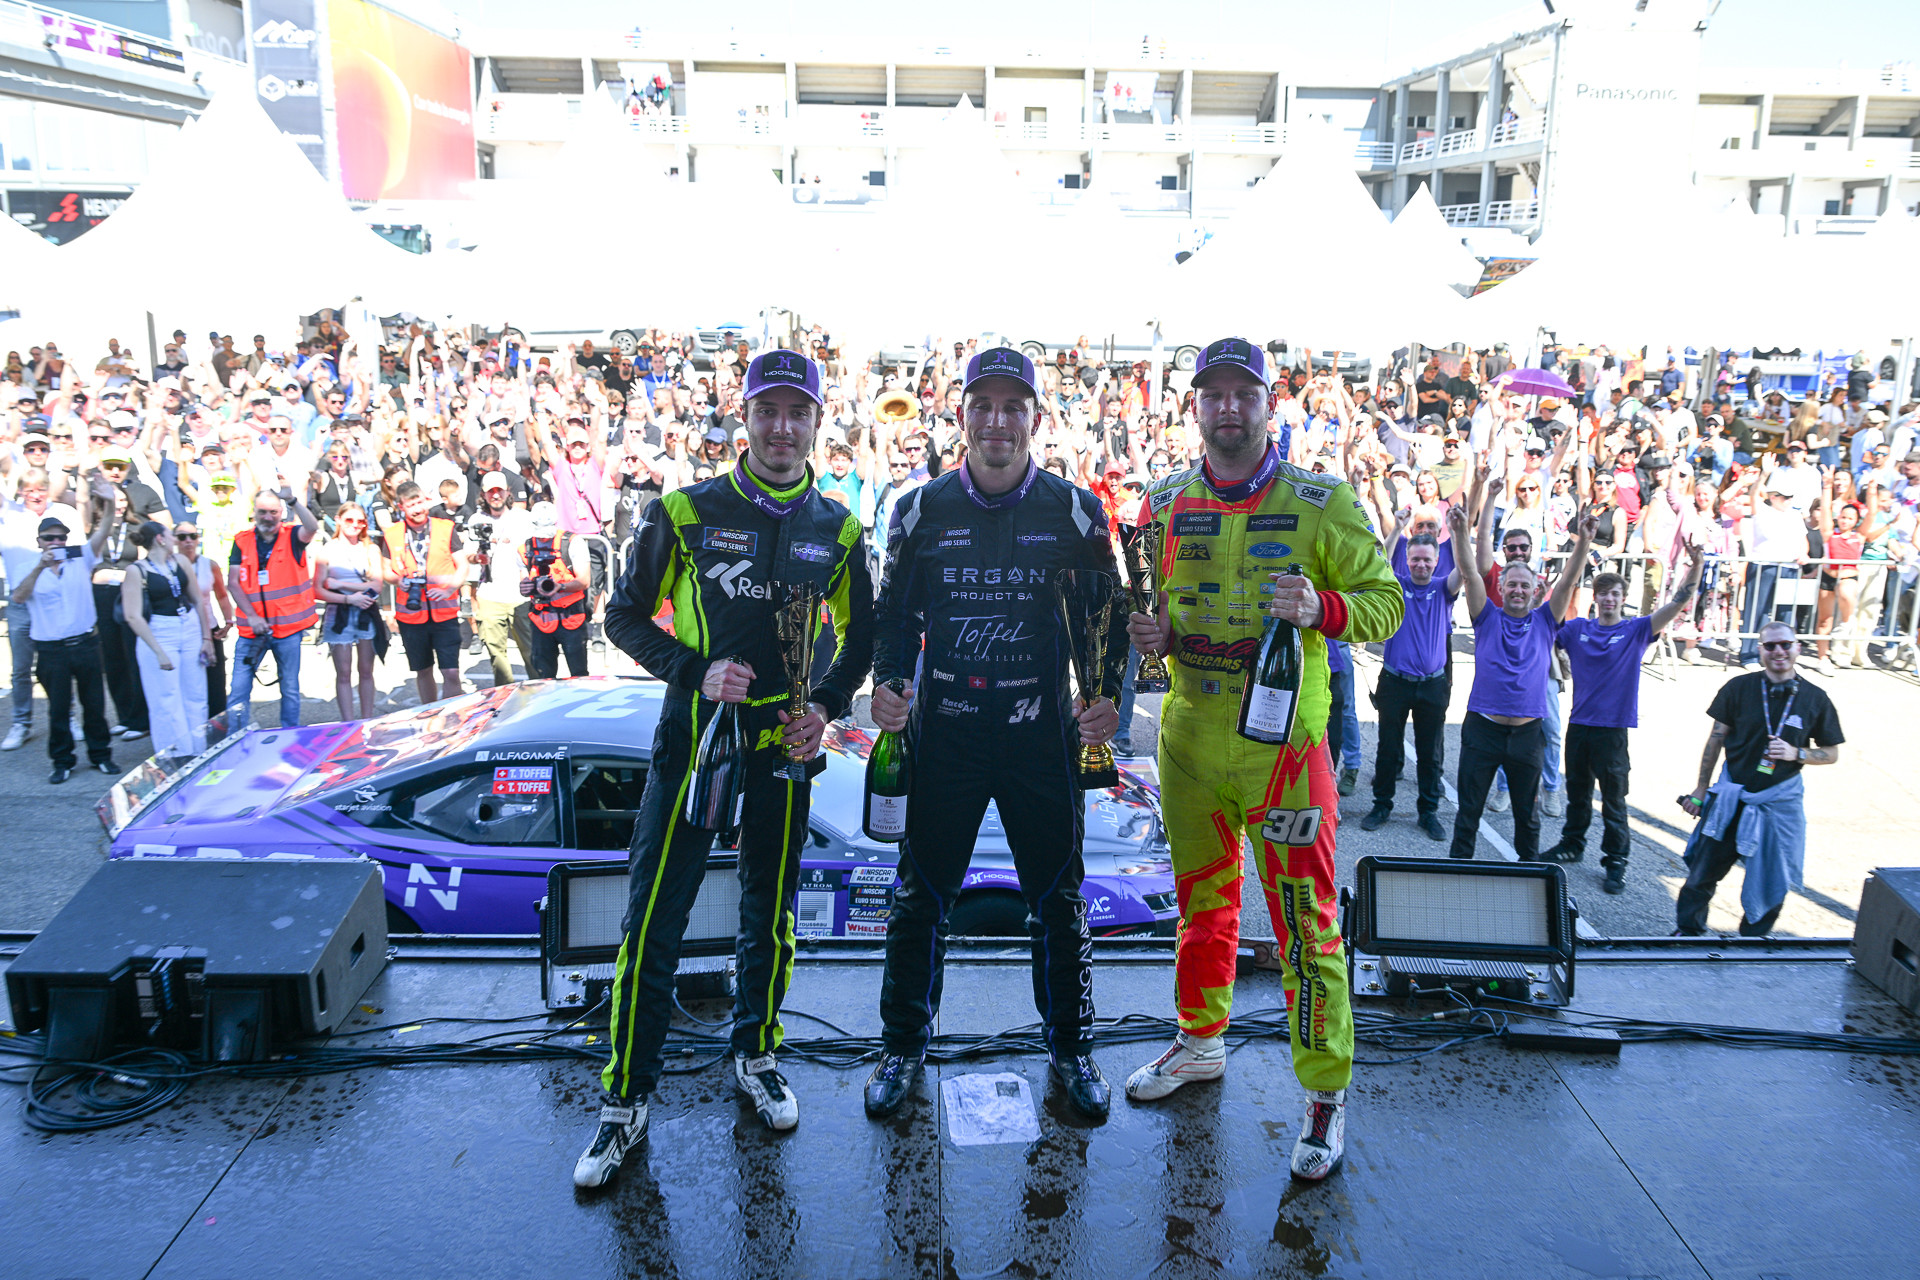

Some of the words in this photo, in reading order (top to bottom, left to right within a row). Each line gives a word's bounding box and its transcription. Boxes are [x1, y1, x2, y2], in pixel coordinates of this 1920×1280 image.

[1576, 83, 1678, 101] Panasonic
[1208, 353, 1247, 363] HOOSIER
[982, 364, 1020, 373] HOOSIER
[764, 370, 804, 380] HOOSIER
[1153, 492, 1172, 505] OMP
[1301, 487, 1326, 500] OMP
[1188, 515, 1213, 523] NASCAR
[1250, 518, 1294, 526] HOOSIER
[946, 528, 971, 537] NASCAR
[1179, 525, 1193, 533] EURO
[1194, 525, 1212, 533] SERIES
[721, 531, 749, 541] NASCAR
[1016, 534, 1057, 542] HOOSIER
[711, 540, 727, 549] EURO
[728, 543, 748, 552] SERIES
[953, 538, 971, 546] SERIES
[794, 547, 830, 558] HOOSIER
[1256, 544, 1284, 555] Ford
[950, 591, 1013, 601] PROJECT
[1017, 592, 1034, 601] SA
[949, 614, 1036, 659] Toffel
[947, 650, 1033, 662] IMMOBILIER
[1178, 650, 1243, 671] RACECARS
[932, 667, 956, 682] freem
[1008, 695, 1042, 724] 34
[1250, 718, 1281, 730] VOUVRAY
[755, 723, 786, 751] 24
[491, 751, 565, 761] ALFAGAMME
[509, 769, 517, 778] T.
[519, 768, 551, 778] TOFFEL
[507, 782, 515, 792] T.
[517, 782, 549, 793] TOFFEL
[872, 822, 901, 831] VOUVRAY
[1262, 808, 1322, 844] 30
[865, 869, 892, 877] NASCAR
[869, 897, 887, 905] SERIES
[1089, 895, 1110, 914] AC
[1285, 890, 1294, 926] ROOST
[1299, 978, 1310, 1041] BERTRANGE
[1317, 1090, 1337, 1099] OMP
[1300, 1152, 1323, 1172] OMP
